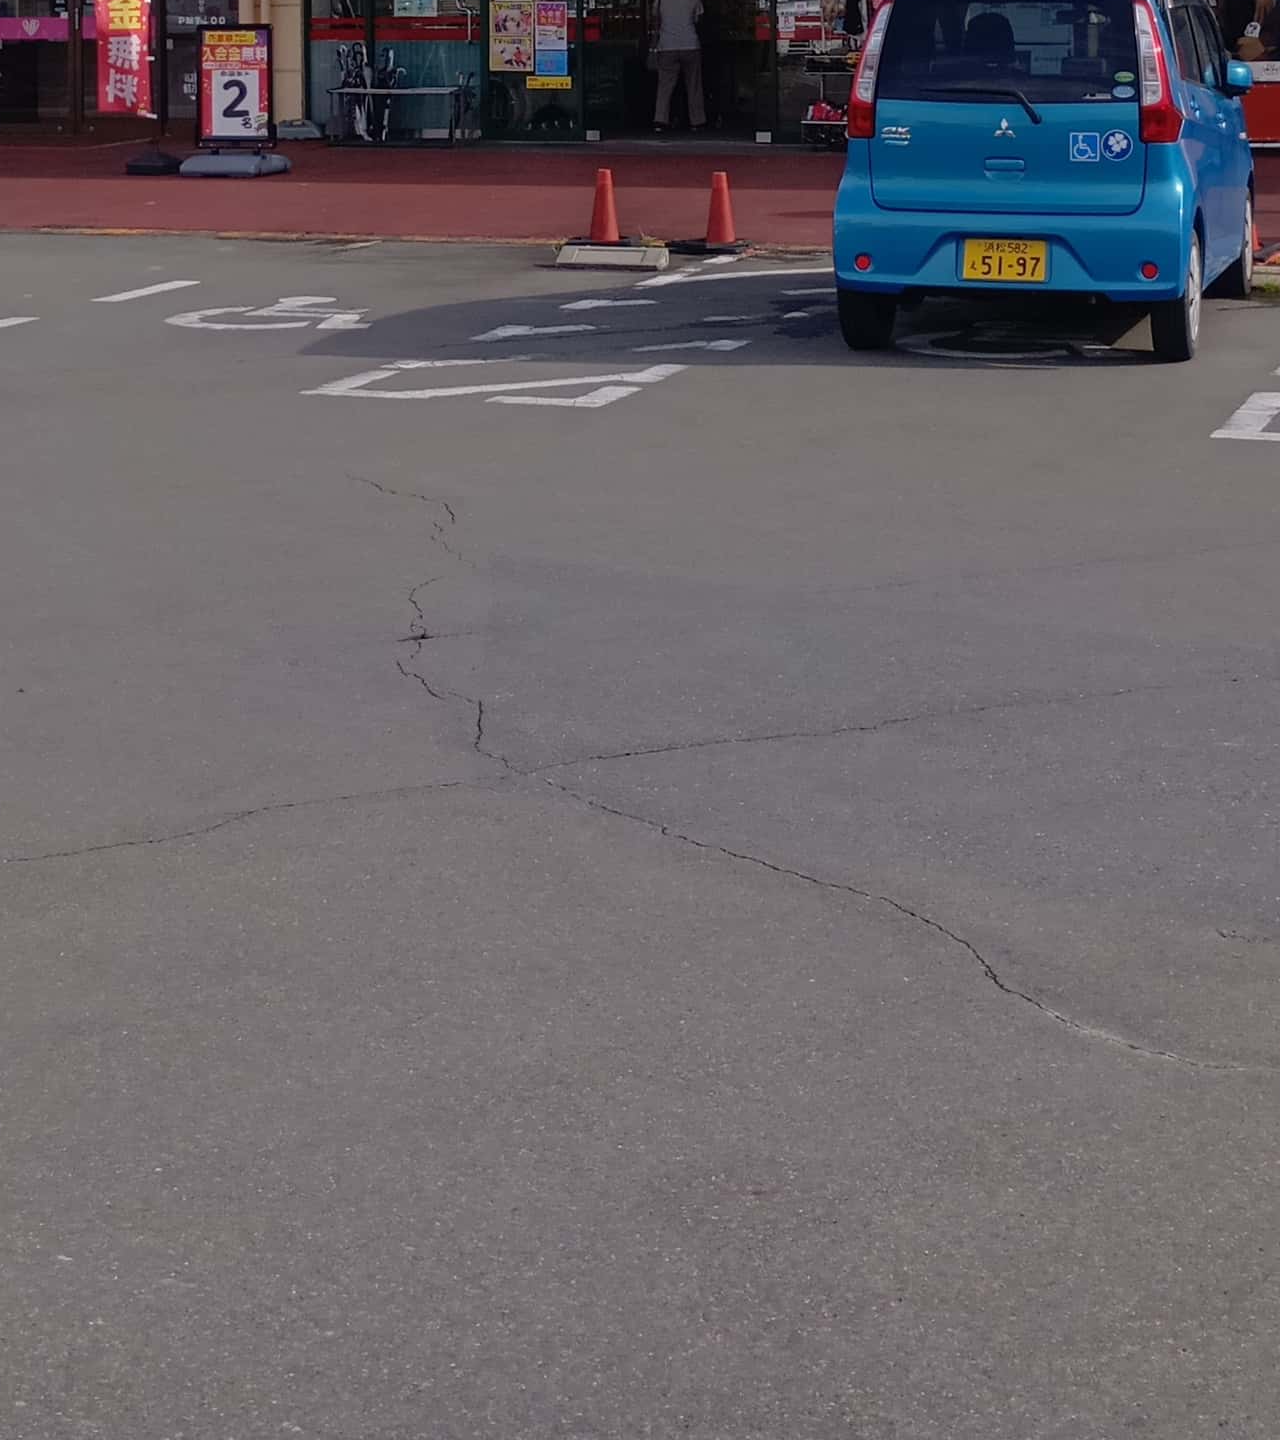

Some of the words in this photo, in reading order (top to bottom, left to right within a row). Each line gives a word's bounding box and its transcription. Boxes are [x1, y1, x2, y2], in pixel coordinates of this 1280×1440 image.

[222, 79, 250, 118] 2
[1007, 242, 1028, 254] 582
[981, 256, 1041, 277] 51-97
